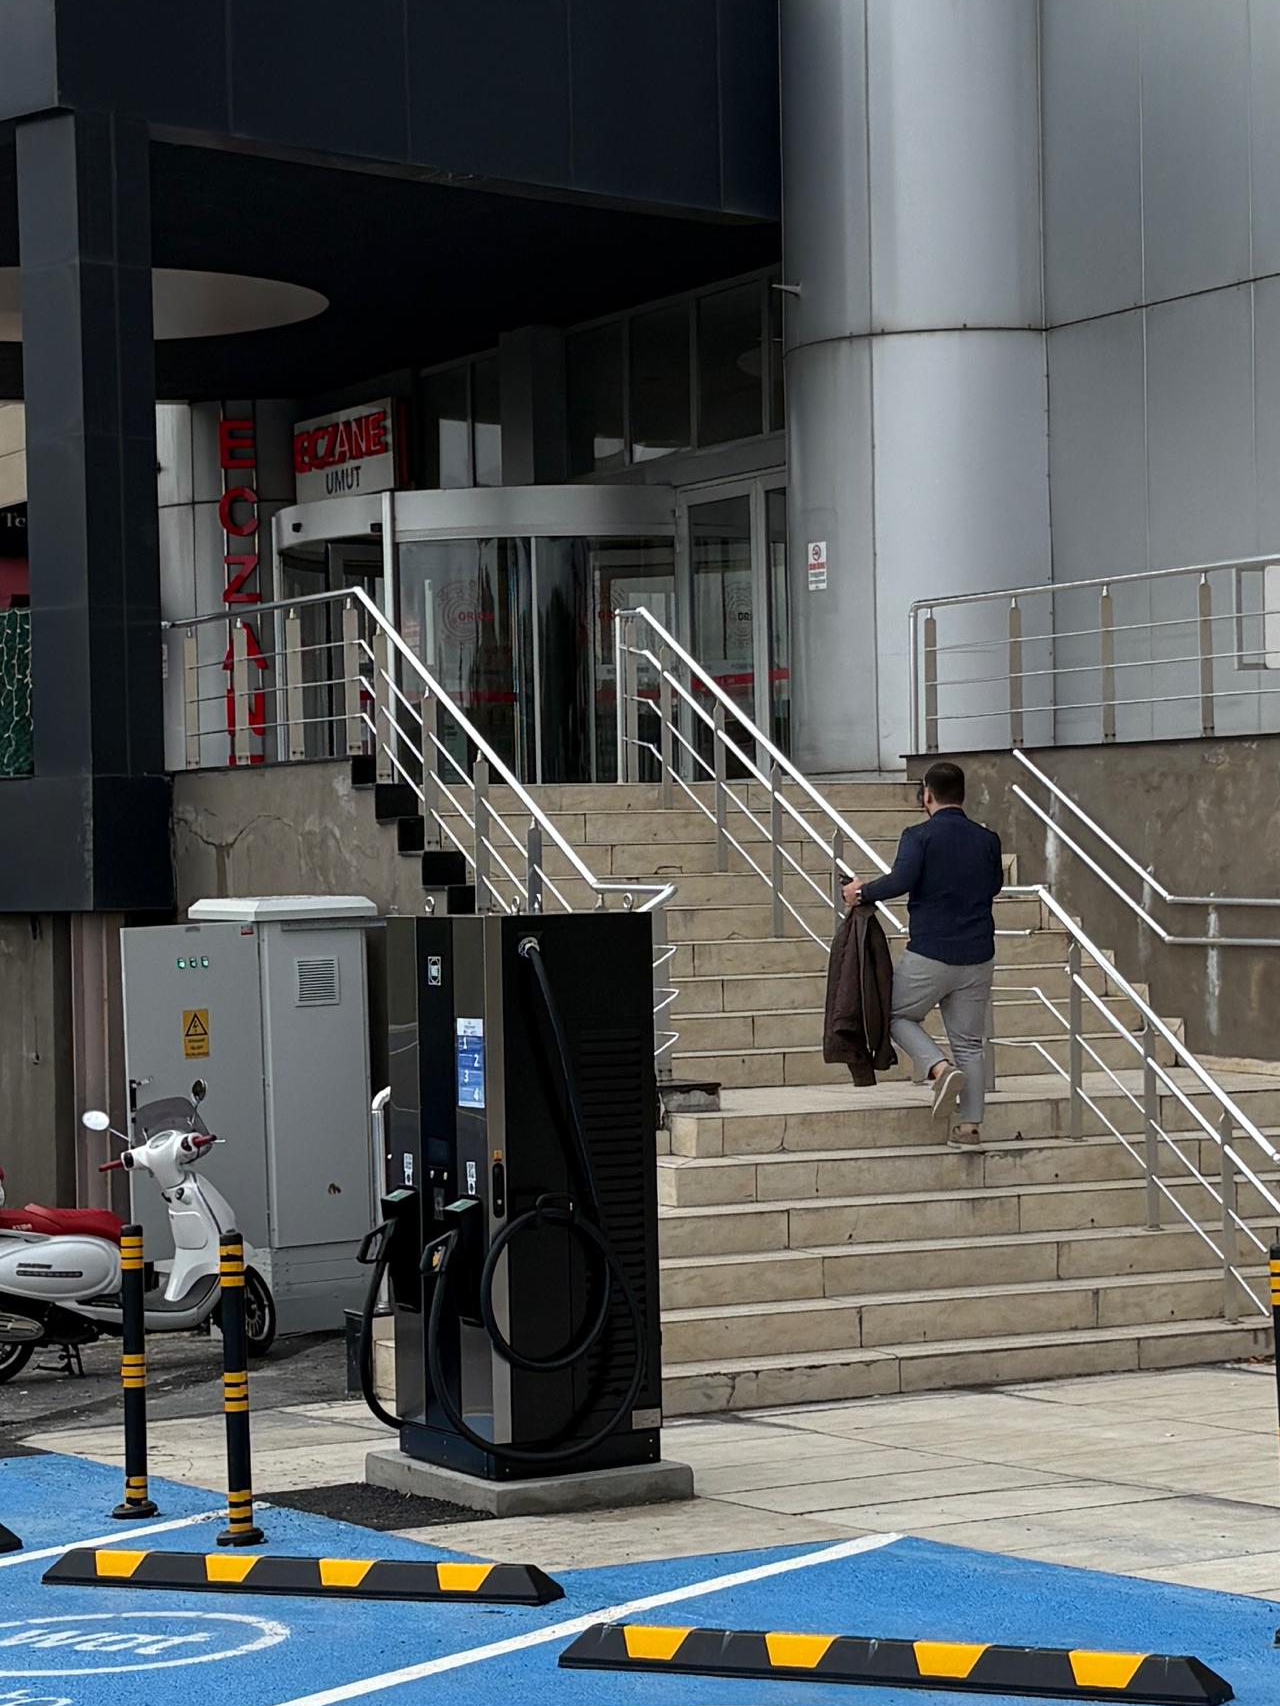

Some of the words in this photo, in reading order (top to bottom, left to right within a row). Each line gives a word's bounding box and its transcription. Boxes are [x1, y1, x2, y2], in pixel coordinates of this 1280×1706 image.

[294, 410, 387, 475] ECZANE
[326, 466, 361, 494] UMUT
[219, 420, 268, 766] ECZAN
